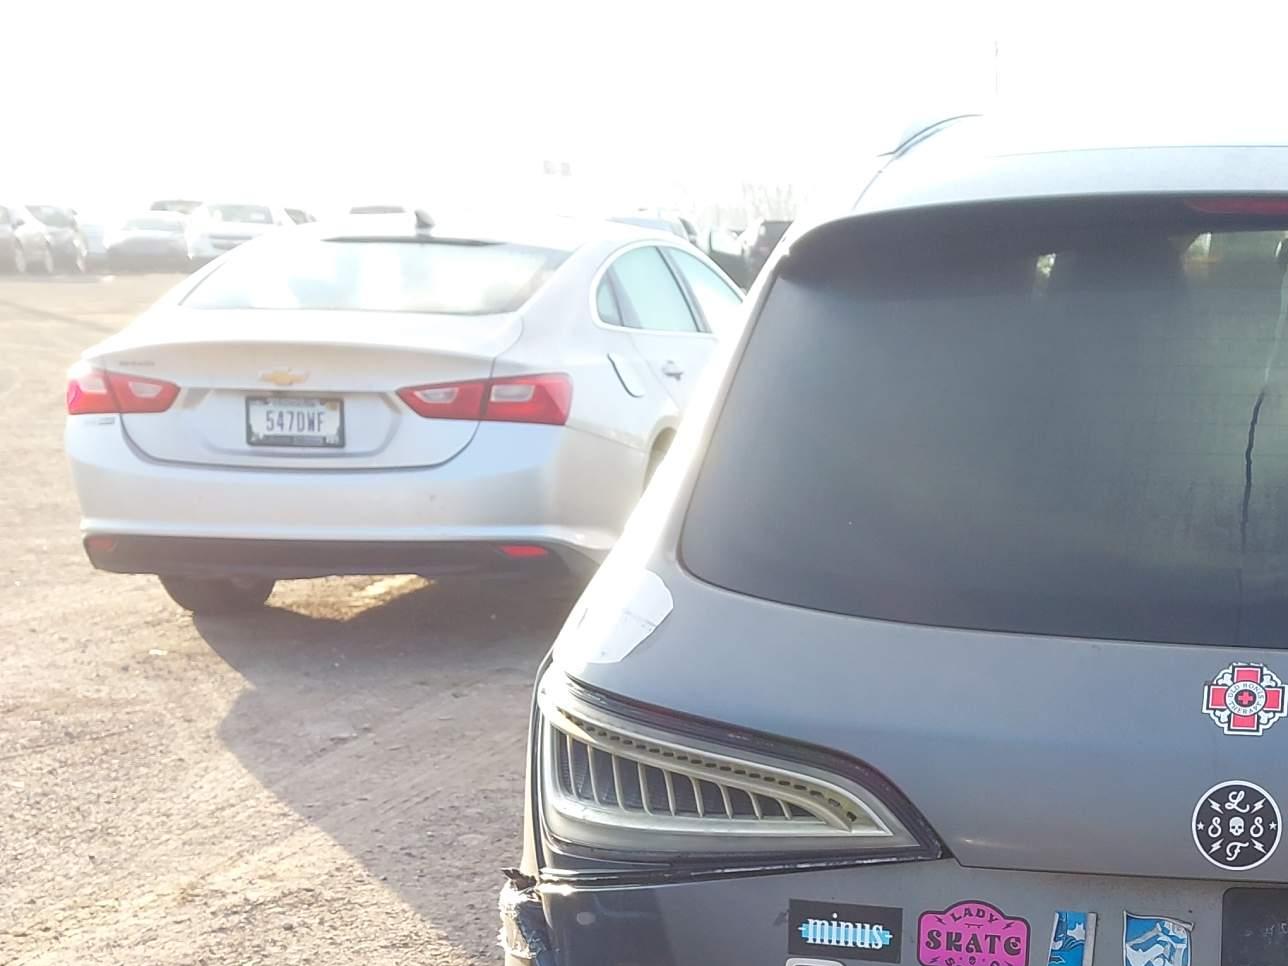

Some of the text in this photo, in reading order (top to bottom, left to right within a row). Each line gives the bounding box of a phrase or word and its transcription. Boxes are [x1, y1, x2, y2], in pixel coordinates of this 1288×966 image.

[1224, 790, 1250, 813] L
[950, 907, 999, 923] LADY
[806, 912, 884, 950] minus
[925, 929, 1022, 956] SKATE
